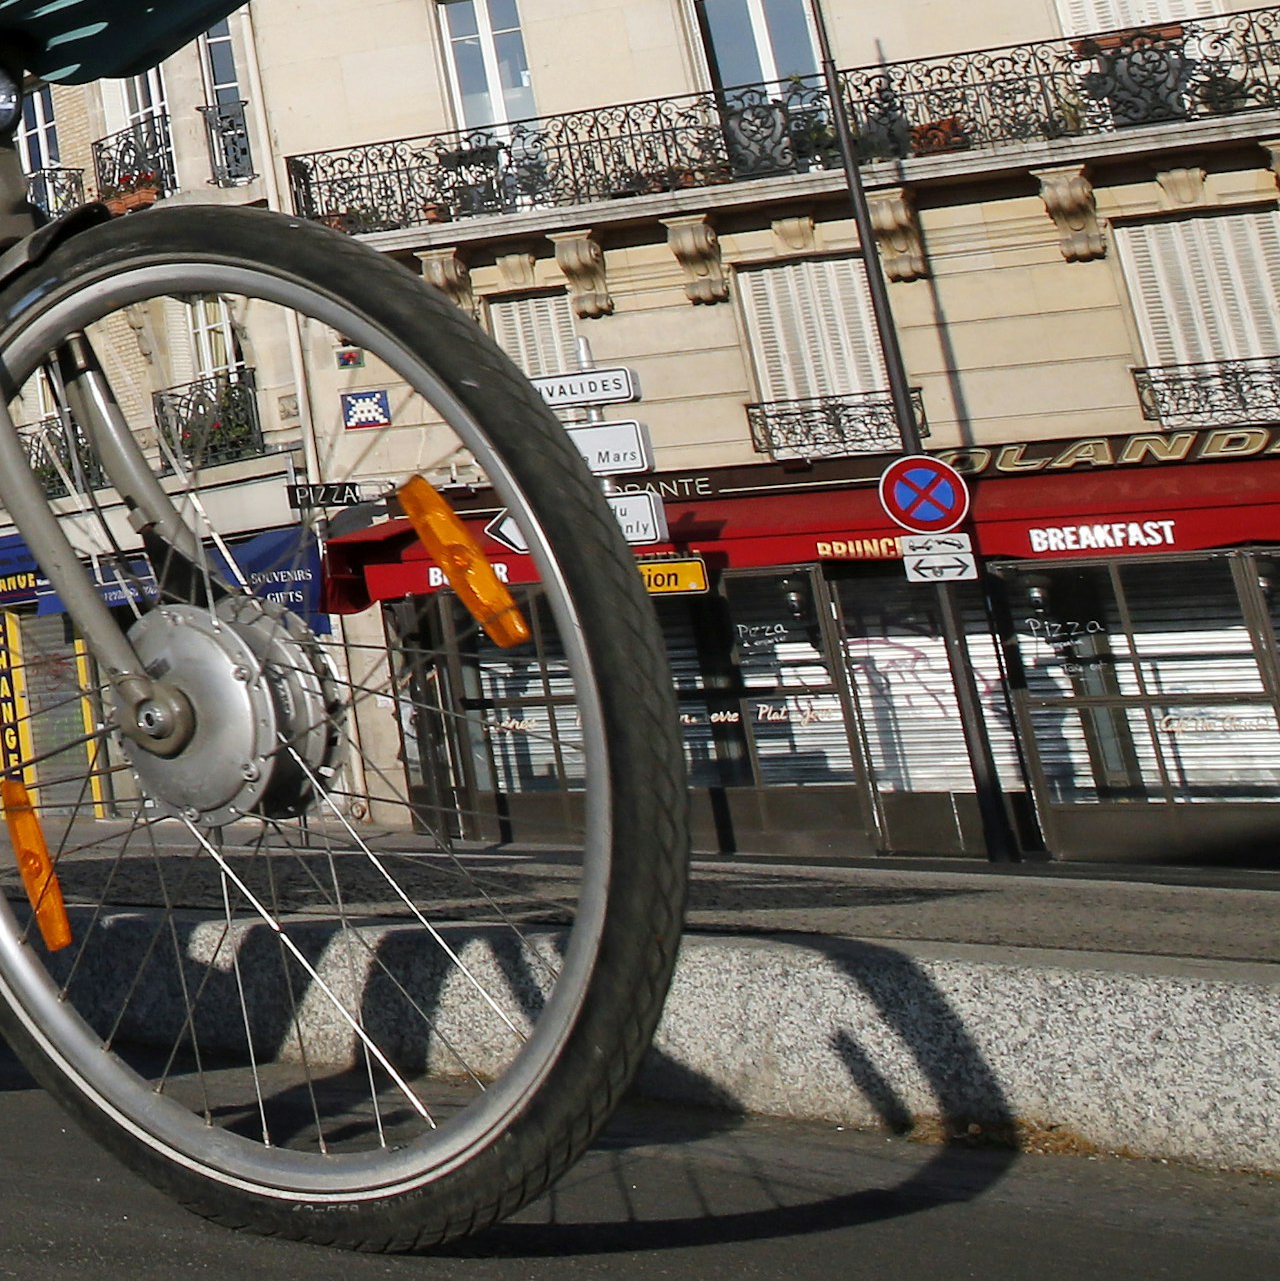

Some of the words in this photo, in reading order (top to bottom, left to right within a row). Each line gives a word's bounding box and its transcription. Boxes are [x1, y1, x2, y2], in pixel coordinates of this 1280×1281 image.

[597, 450, 637, 464] Mars
[296, 485, 358, 506] PIZZA
[1029, 520, 1175, 552] BREAKFAST
[251, 569, 313, 584] SOUVENIRS
[1025, 618, 1106, 638] Pizza
[756, 704, 789, 721] Plat
